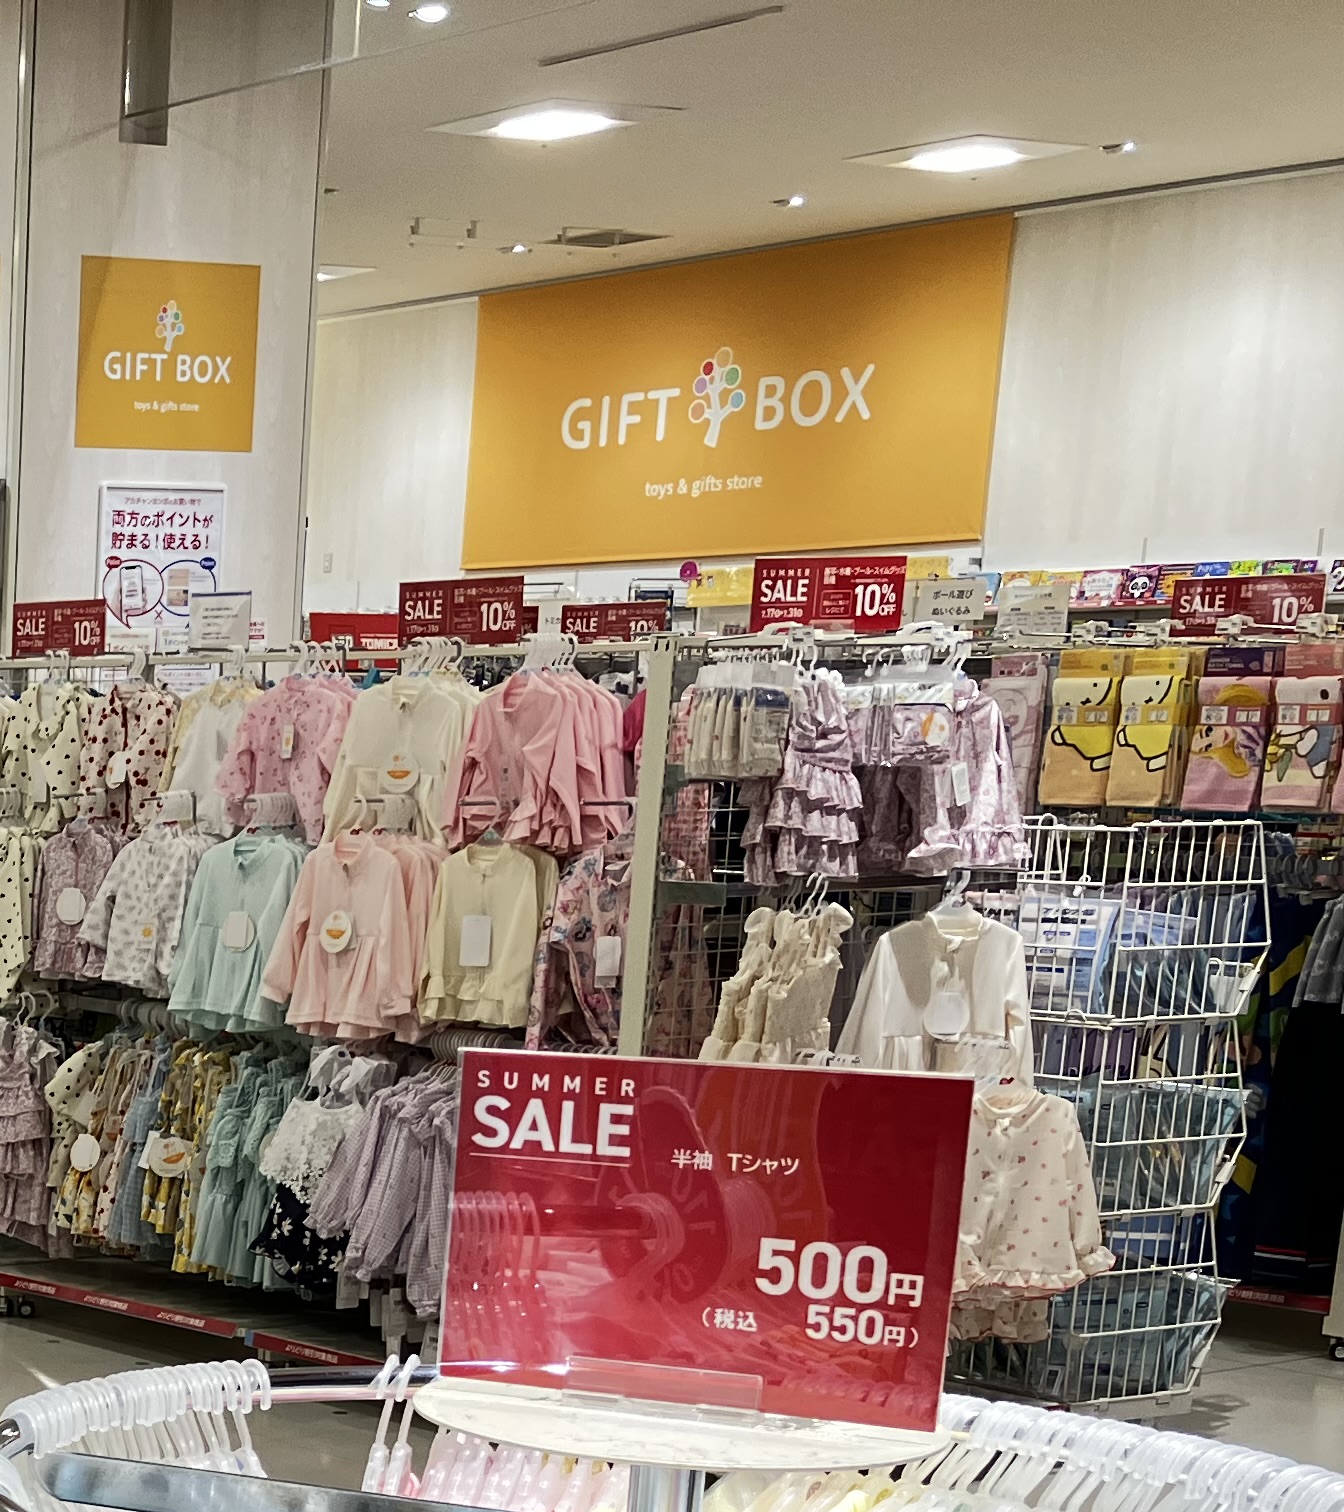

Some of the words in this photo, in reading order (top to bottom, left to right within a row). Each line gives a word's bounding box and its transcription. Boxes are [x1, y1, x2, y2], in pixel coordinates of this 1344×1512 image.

[103, 351, 169, 382] GIFT
[176, 354, 233, 385] BOX
[134, 400, 151, 411] toys
[161, 400, 178, 412] gifts
[179, 402, 199, 411] store
[561, 386, 680, 451] GIFT
[754, 363, 876, 432] BOX
[644, 478, 673, 500] toys
[676, 476, 689, 494] &
[691, 474, 722, 498] gifts
[726, 472, 763, 491] store
[112, 509, 214, 528] 両方のポイントが
[111, 532, 209, 550] 貯まる!使える!
[762, 568, 810, 578] SUMMER
[404, 590, 444, 599] SUMMER
[760, 579, 810, 602] SALE
[854, 583, 896, 617] 10%
[1182, 585, 1227, 594] SUMMER
[404, 600, 443, 621] SALE
[879, 604, 897, 616] OFF
[931, 606, 971, 616] ぬいぐるみ
[1179, 594, 1226, 613] SALE
[1272, 596, 1314, 624] 10%
[16, 618, 46, 636] SALE
[480, 601, 516, 632] 10%
[502, 620, 517, 631] OFF
[566, 617, 598, 634] SALE
[74, 620, 101, 646] 10%
[476, 1069, 635, 1098] SUMMER
[472, 1095, 635, 1158] SALE
[671, 1148, 712, 1171] 半袖
[727, 1152, 800, 1175] Tシャツ
[755, 1237, 924, 1308] 500円
[805, 1304, 920, 1350] 550円)
